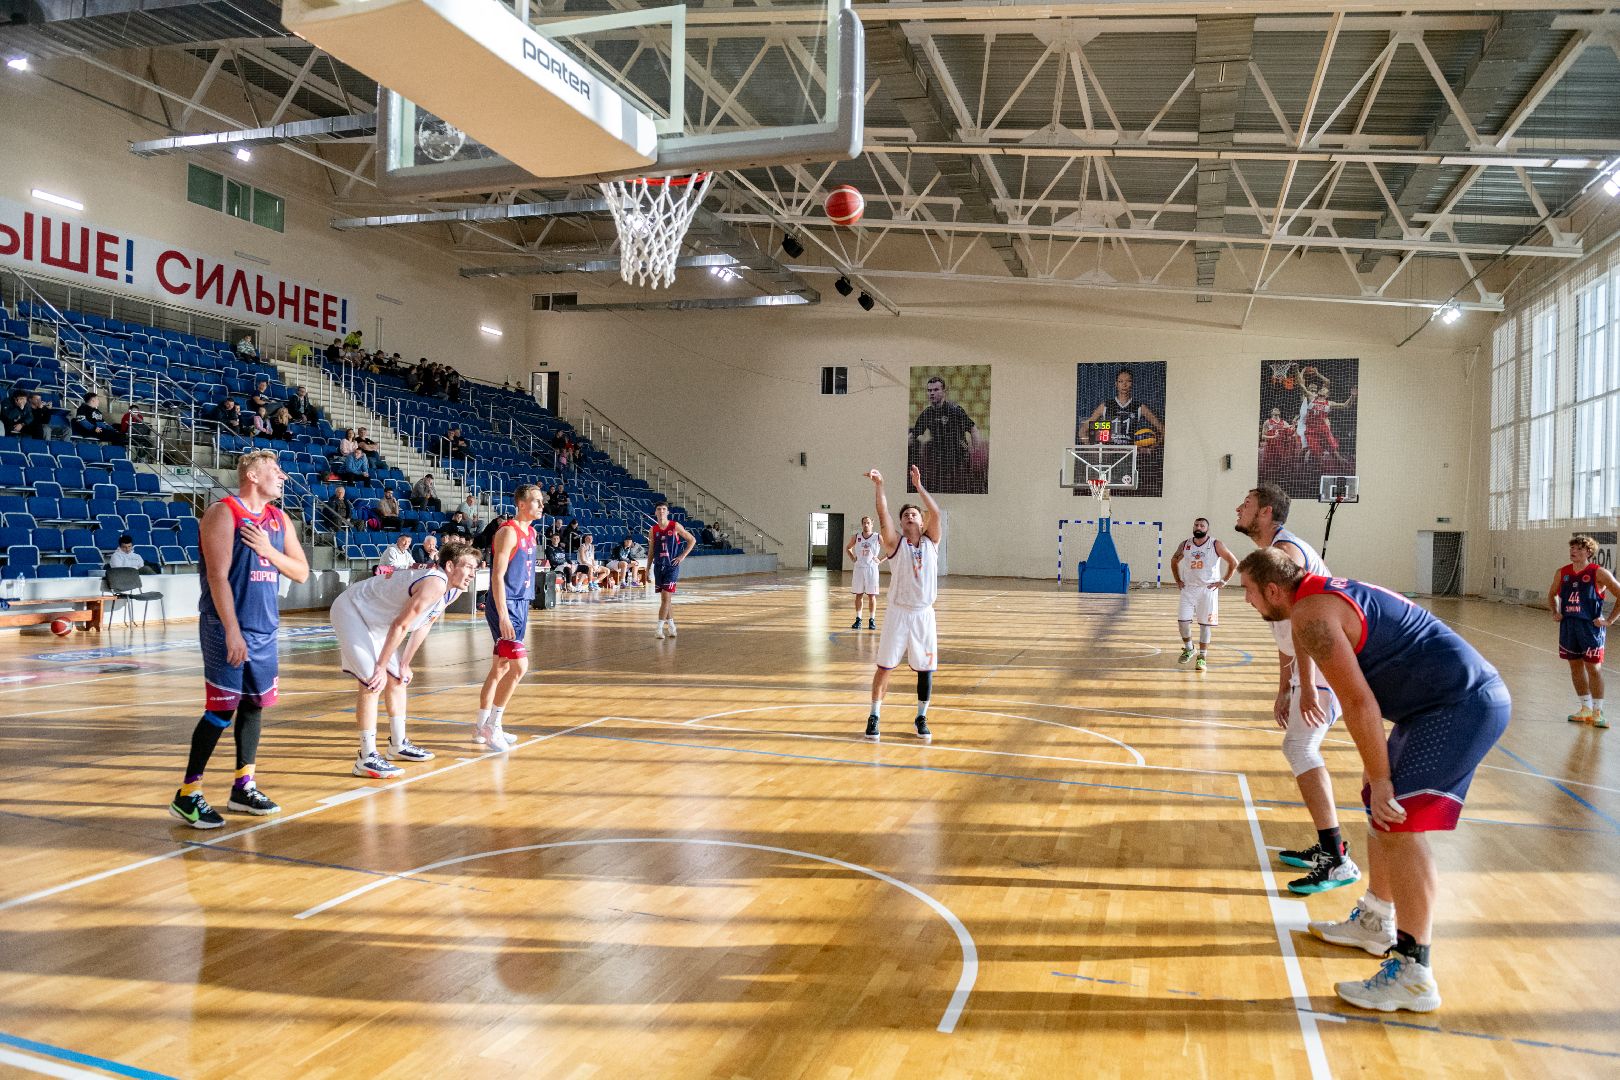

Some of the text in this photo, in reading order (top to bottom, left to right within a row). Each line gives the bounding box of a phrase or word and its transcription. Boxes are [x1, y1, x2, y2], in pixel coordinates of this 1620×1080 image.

[156, 249, 348, 335] СИЛЬНЕЕ!
[1190, 560, 1204, 570] 28
[1585, 646, 1601, 659] 44
